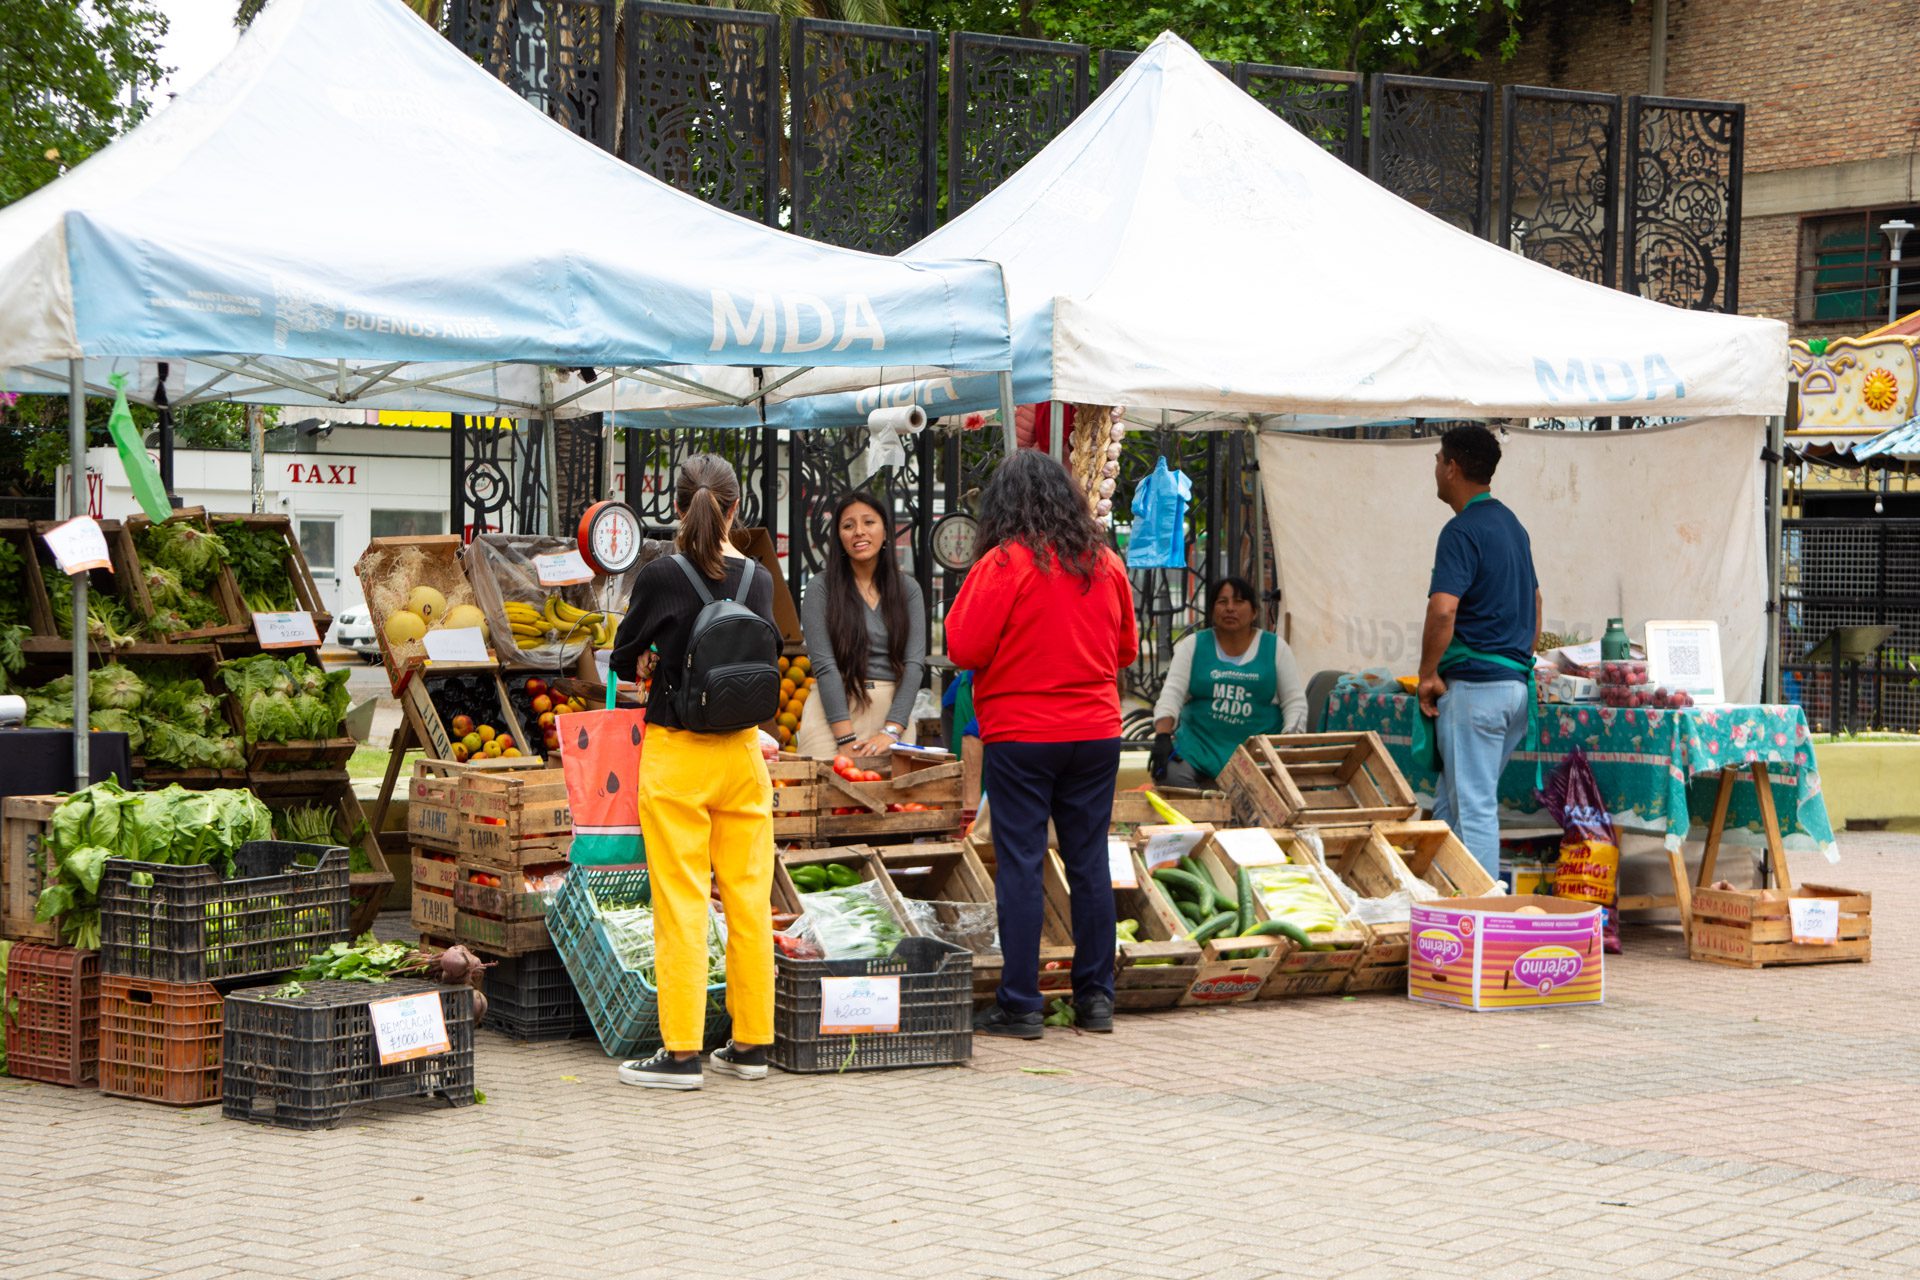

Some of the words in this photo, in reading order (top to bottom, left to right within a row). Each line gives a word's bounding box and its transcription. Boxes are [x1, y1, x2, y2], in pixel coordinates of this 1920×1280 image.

[343, 313, 437, 338] BUENOS
[442, 320, 501, 339] AIRES
[708, 289, 886, 354] MDA
[1531, 353, 1687, 403] MDA
[287, 463, 357, 485] TAXI
[615, 473, 664, 493] TXI
[1213, 683, 1252, 701] MER-
[1211, 699, 1253, 717] CADO
[419, 808, 448, 834] JAIME
[1557, 860, 1611, 880] ERMANOS
[1419, 939, 1458, 957] Ceferino
[1520, 957, 1578, 979] Ceferino
[380, 1014, 434, 1035] REMOLACHA
